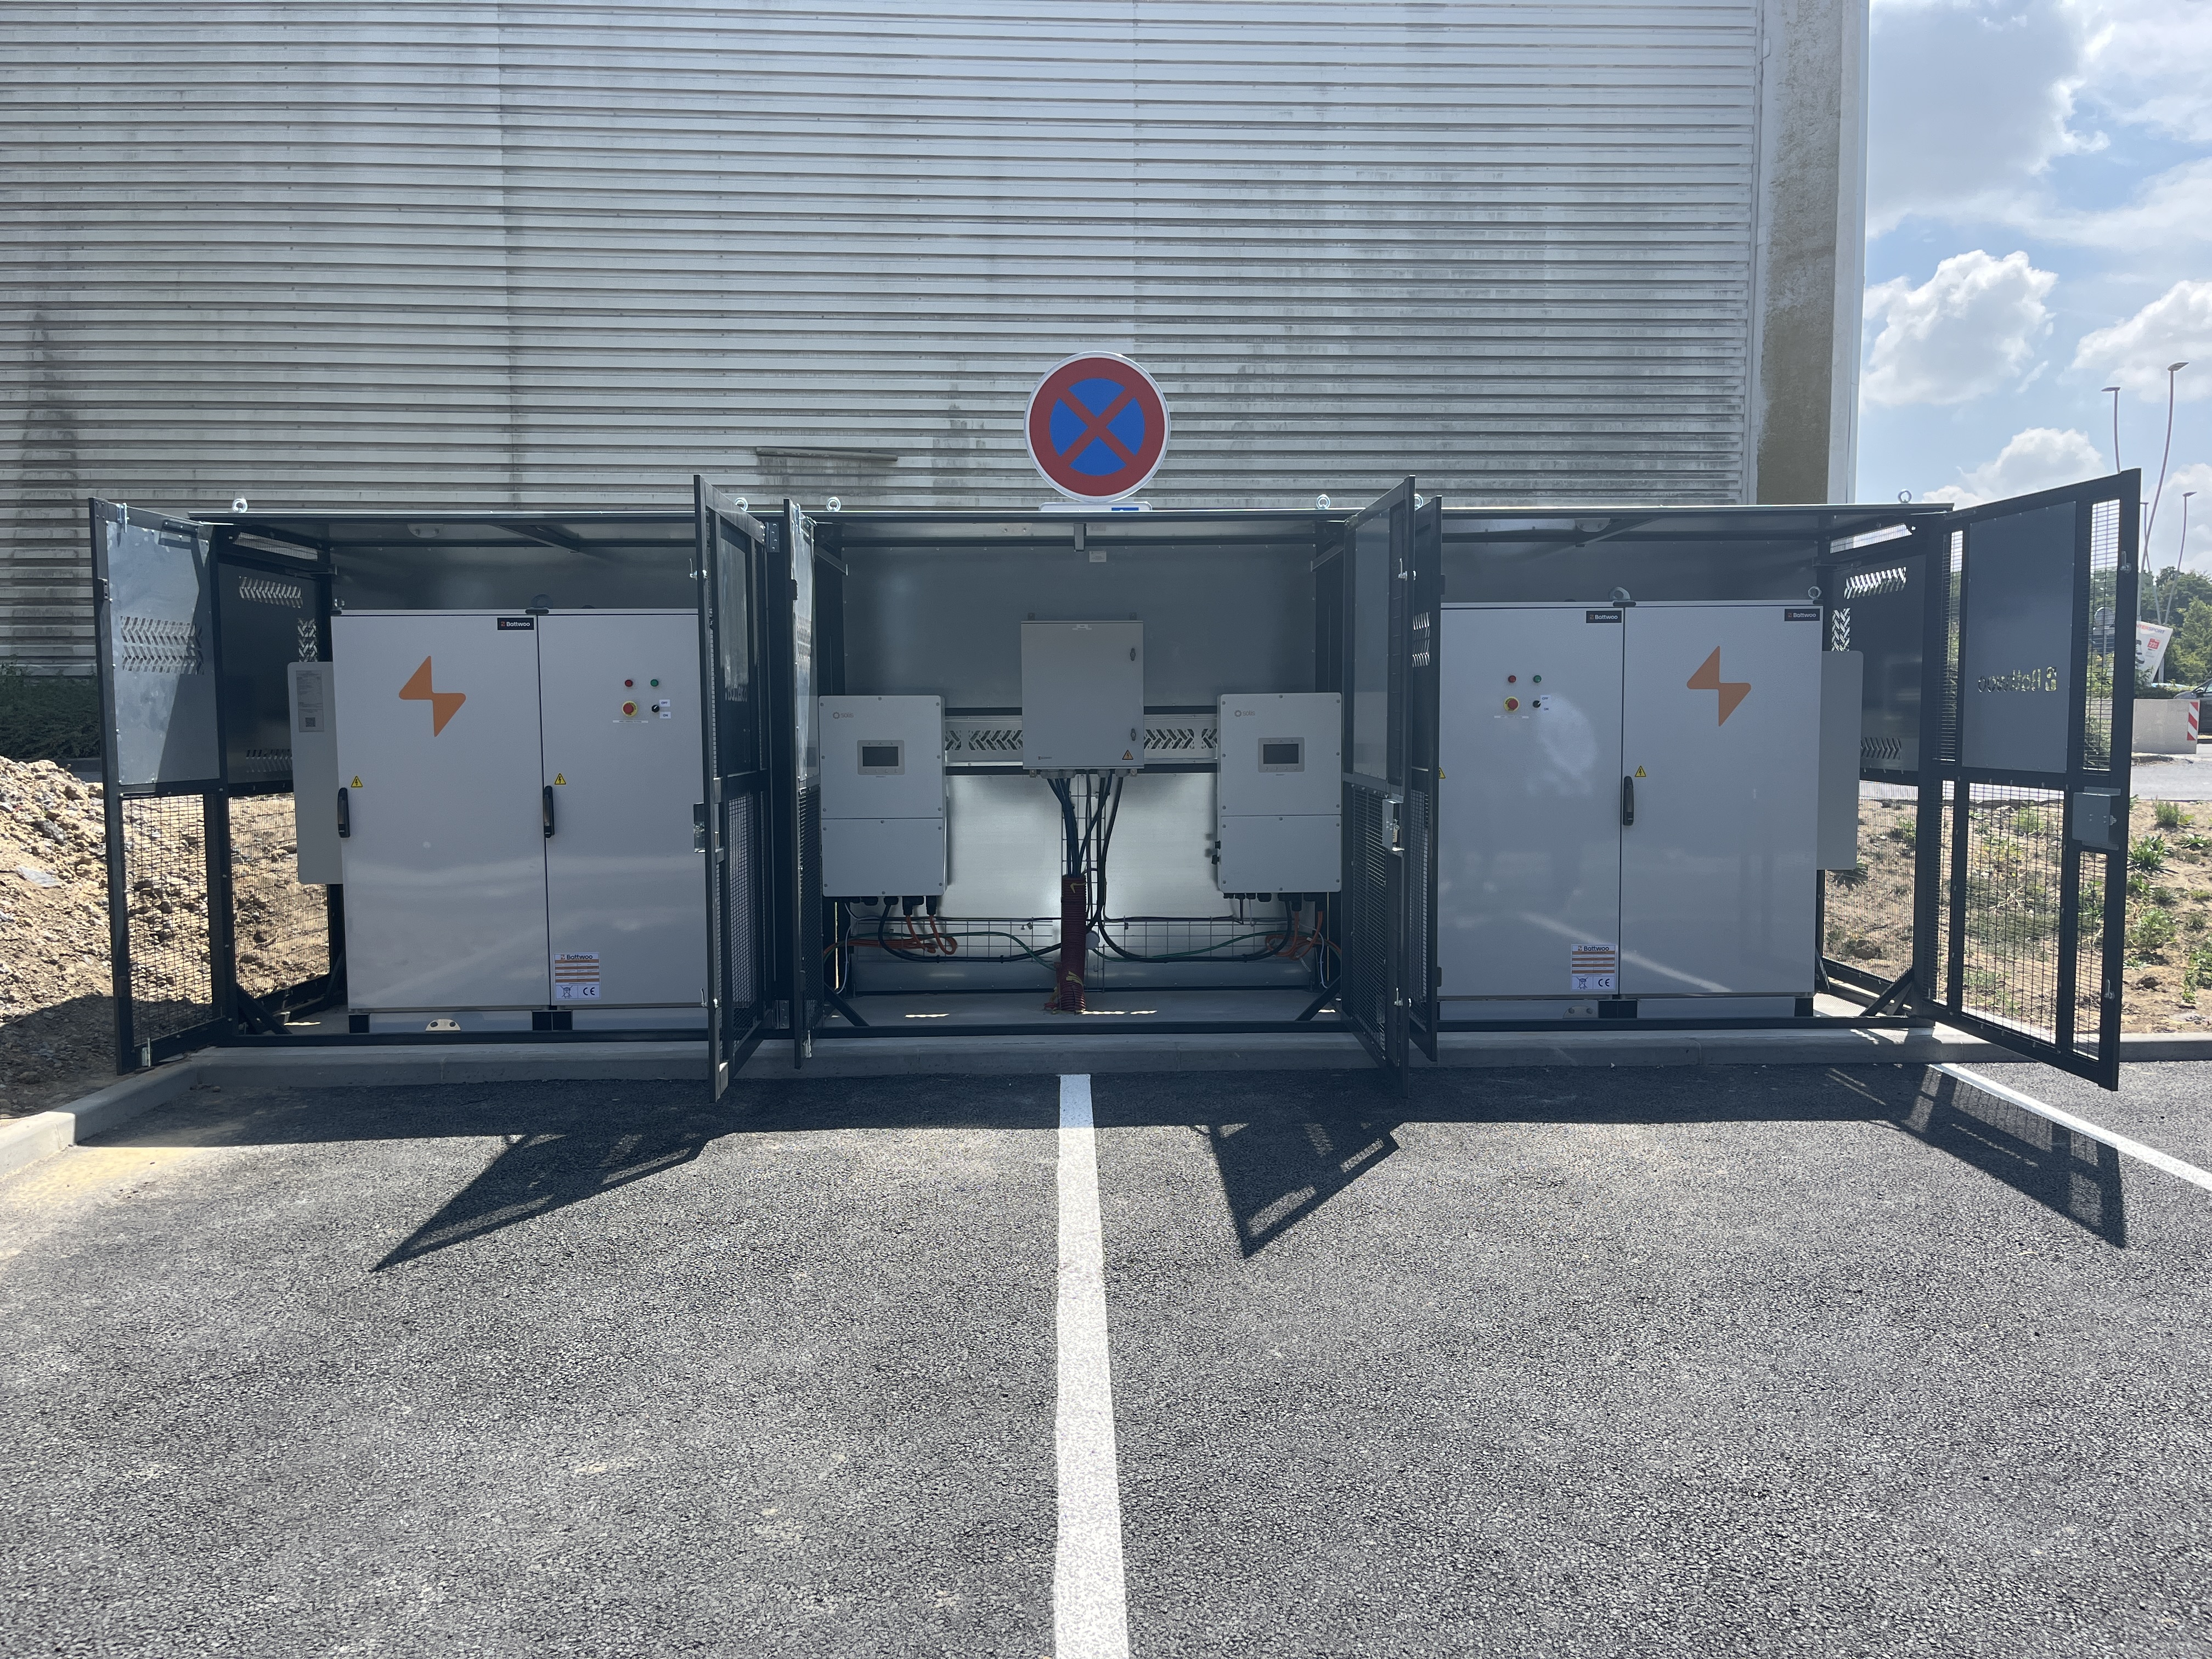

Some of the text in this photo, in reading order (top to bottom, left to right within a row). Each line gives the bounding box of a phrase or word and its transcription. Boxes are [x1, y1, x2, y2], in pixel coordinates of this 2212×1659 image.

[2137, 624, 2165, 634] NTERSPORT
[1598, 978, 1610, 987] CE
[583, 987, 595, 996] CE
